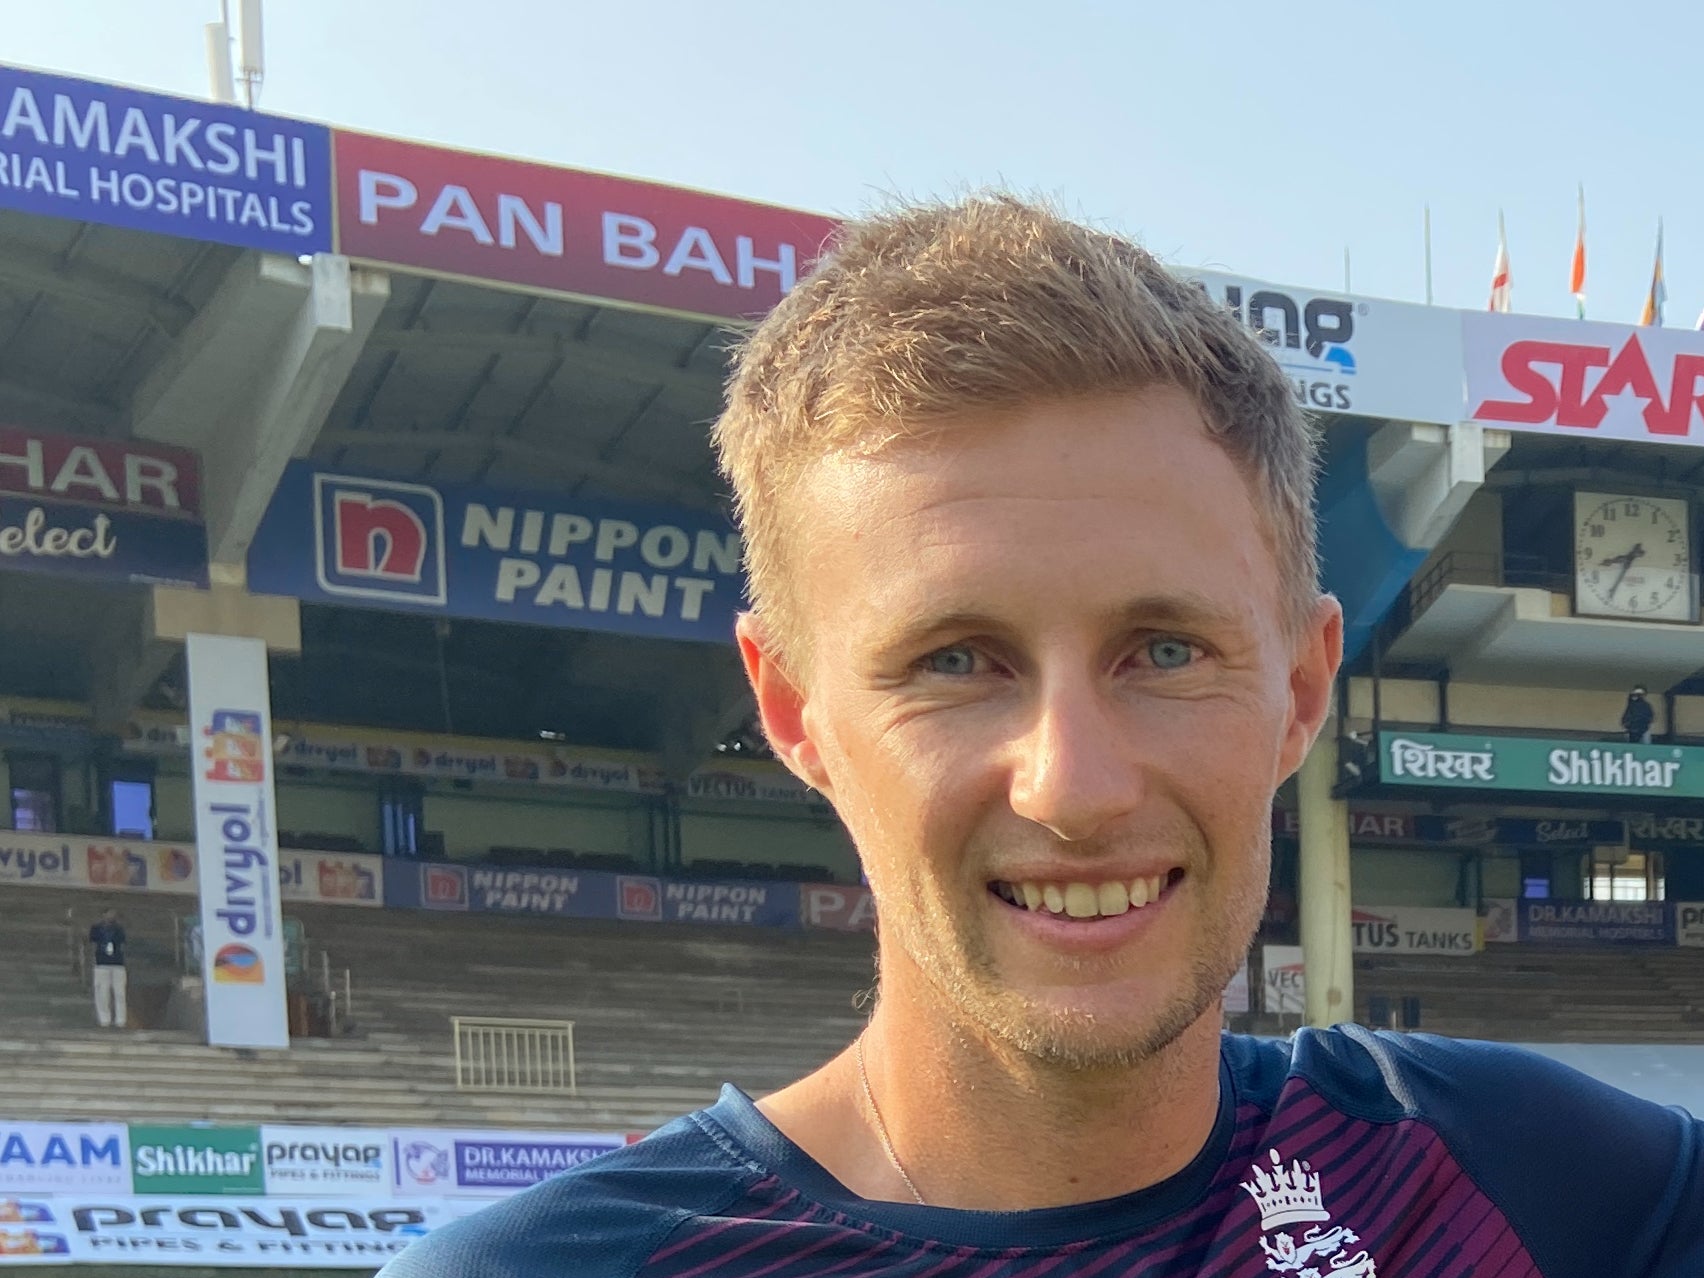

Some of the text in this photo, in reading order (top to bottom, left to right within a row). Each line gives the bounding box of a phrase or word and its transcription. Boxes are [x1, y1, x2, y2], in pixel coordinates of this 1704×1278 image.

[2, 87, 306, 188] AMAKSHI
[90, 166, 314, 236] HOSPITALS
[358, 169, 796, 296] PAN BAH
[461, 503, 741, 574] NIPPON
[496, 558, 714, 621] PAINT
[1549, 748, 1680, 787] Shikhar
[473, 871, 579, 893] NIPPON
[667, 884, 767, 904] NIPPON
[485, 890, 568, 911] PAINT
[678, 903, 757, 921] PAINT
[1406, 930, 1473, 949] TANKS
[137, 1145, 257, 1177] Shikhar
[465, 1168, 543, 1182] MEMORIAL
[72, 1205, 425, 1236] prayag
[89, 1235, 204, 1250] PIPES
